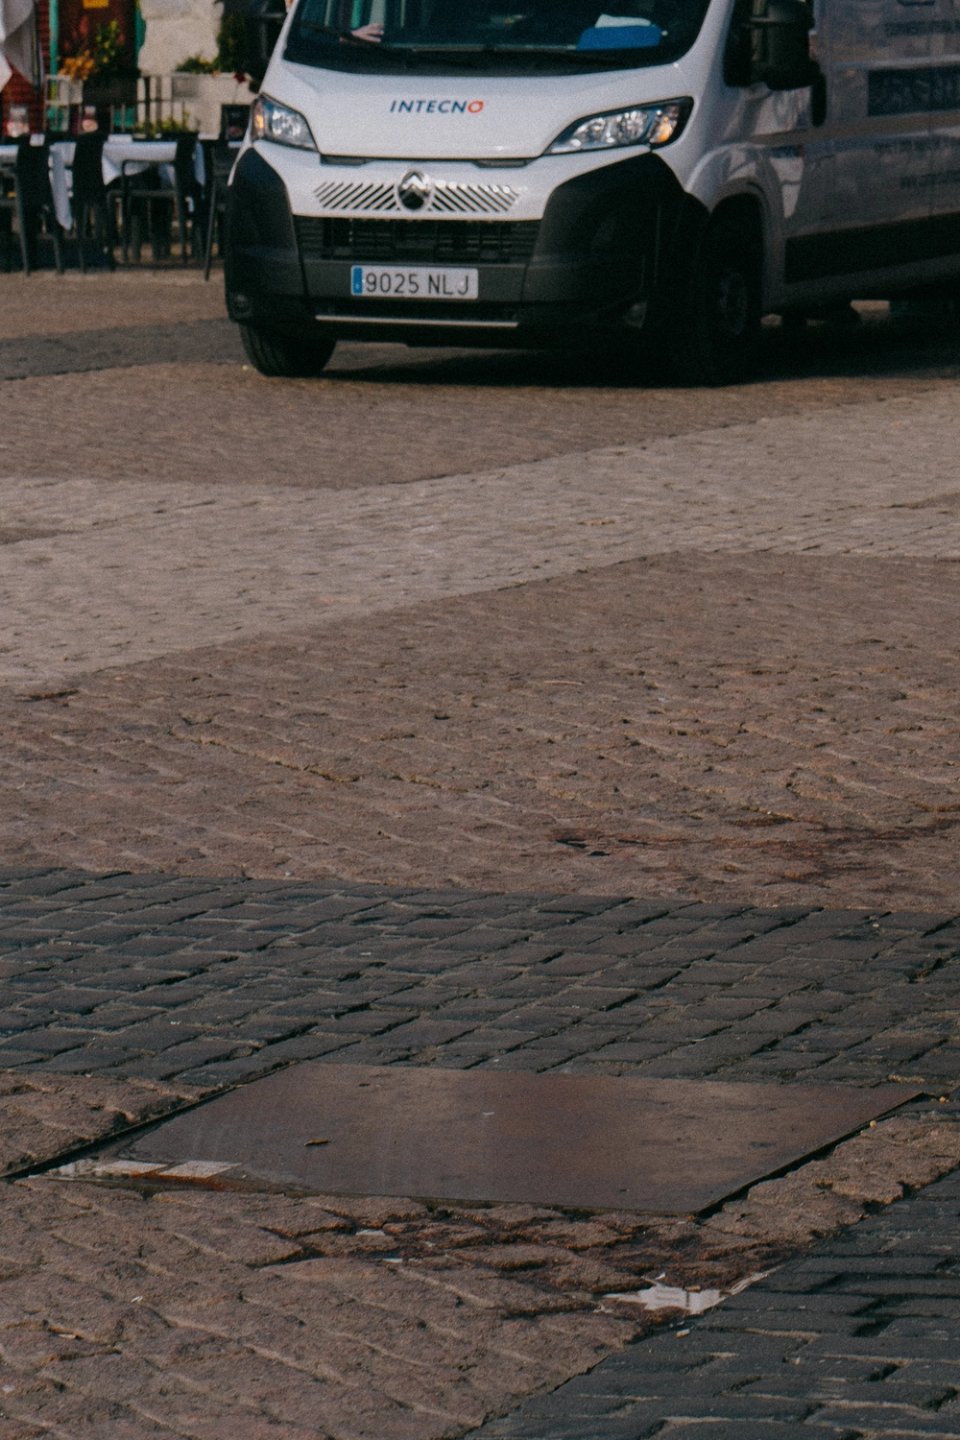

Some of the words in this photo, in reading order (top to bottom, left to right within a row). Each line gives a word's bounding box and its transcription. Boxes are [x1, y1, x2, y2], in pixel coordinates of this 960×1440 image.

[390, 99, 485, 114] INTECNO
[365, 273, 420, 294] 9025
[427, 274, 470, 296] NLJ
